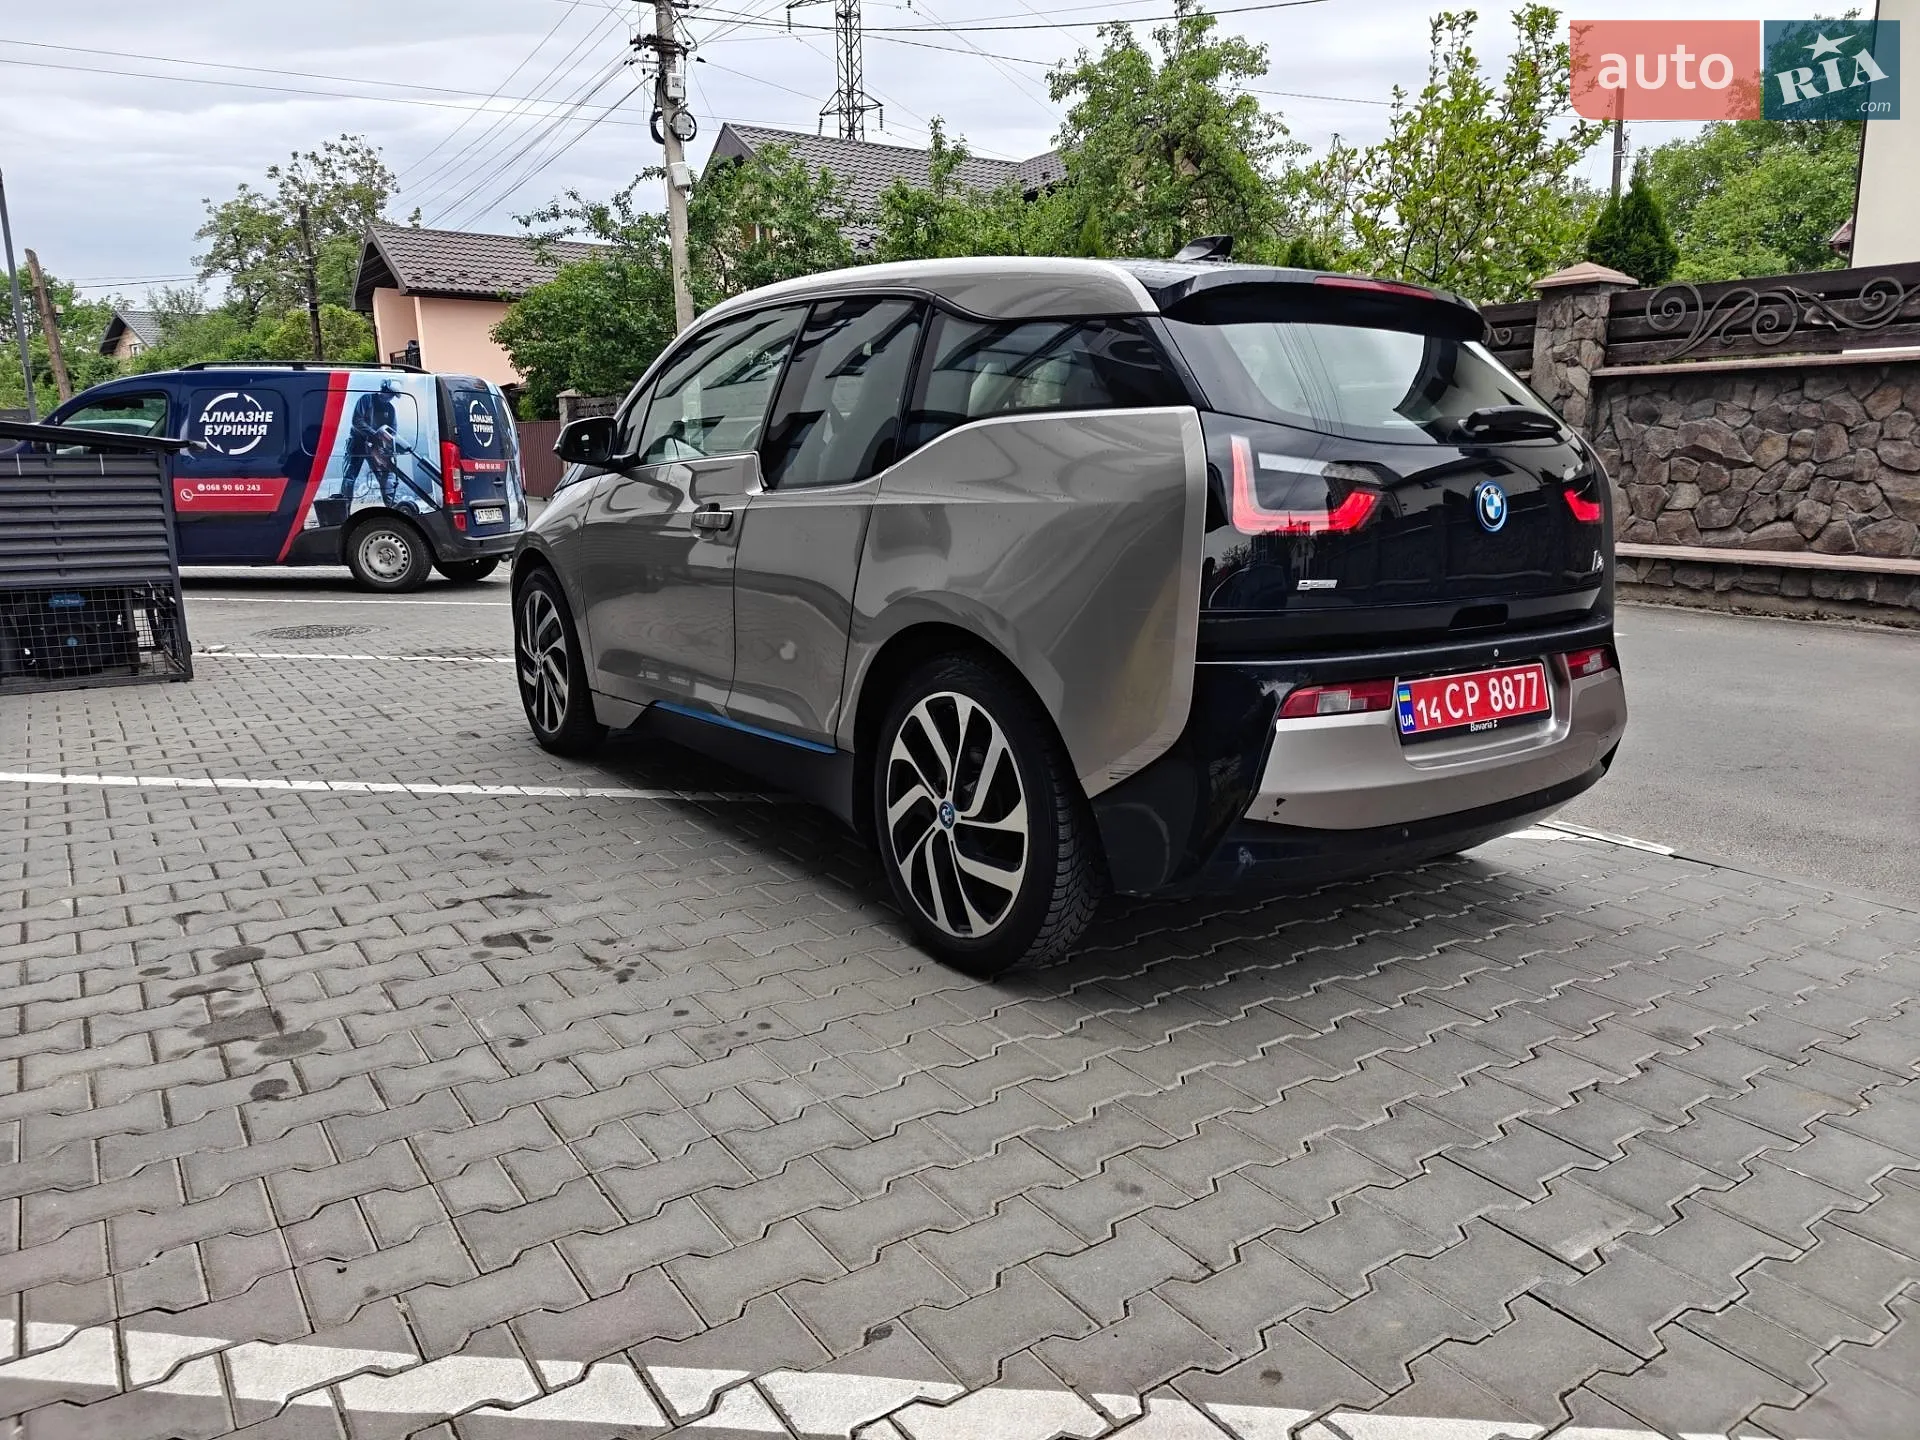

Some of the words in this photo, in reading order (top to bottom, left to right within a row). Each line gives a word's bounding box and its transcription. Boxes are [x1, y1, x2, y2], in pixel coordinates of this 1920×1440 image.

[199, 411, 274, 423] АЛМАЗНЕ
[204, 424, 268, 436] БУРІННЯ
[1416, 696, 1442, 726] 14
[1445, 680, 1480, 719] CP
[1488, 671, 1538, 712] 8877
[1401, 714, 1415, 727] UA
[1470, 721, 1493, 732] Bavaria
